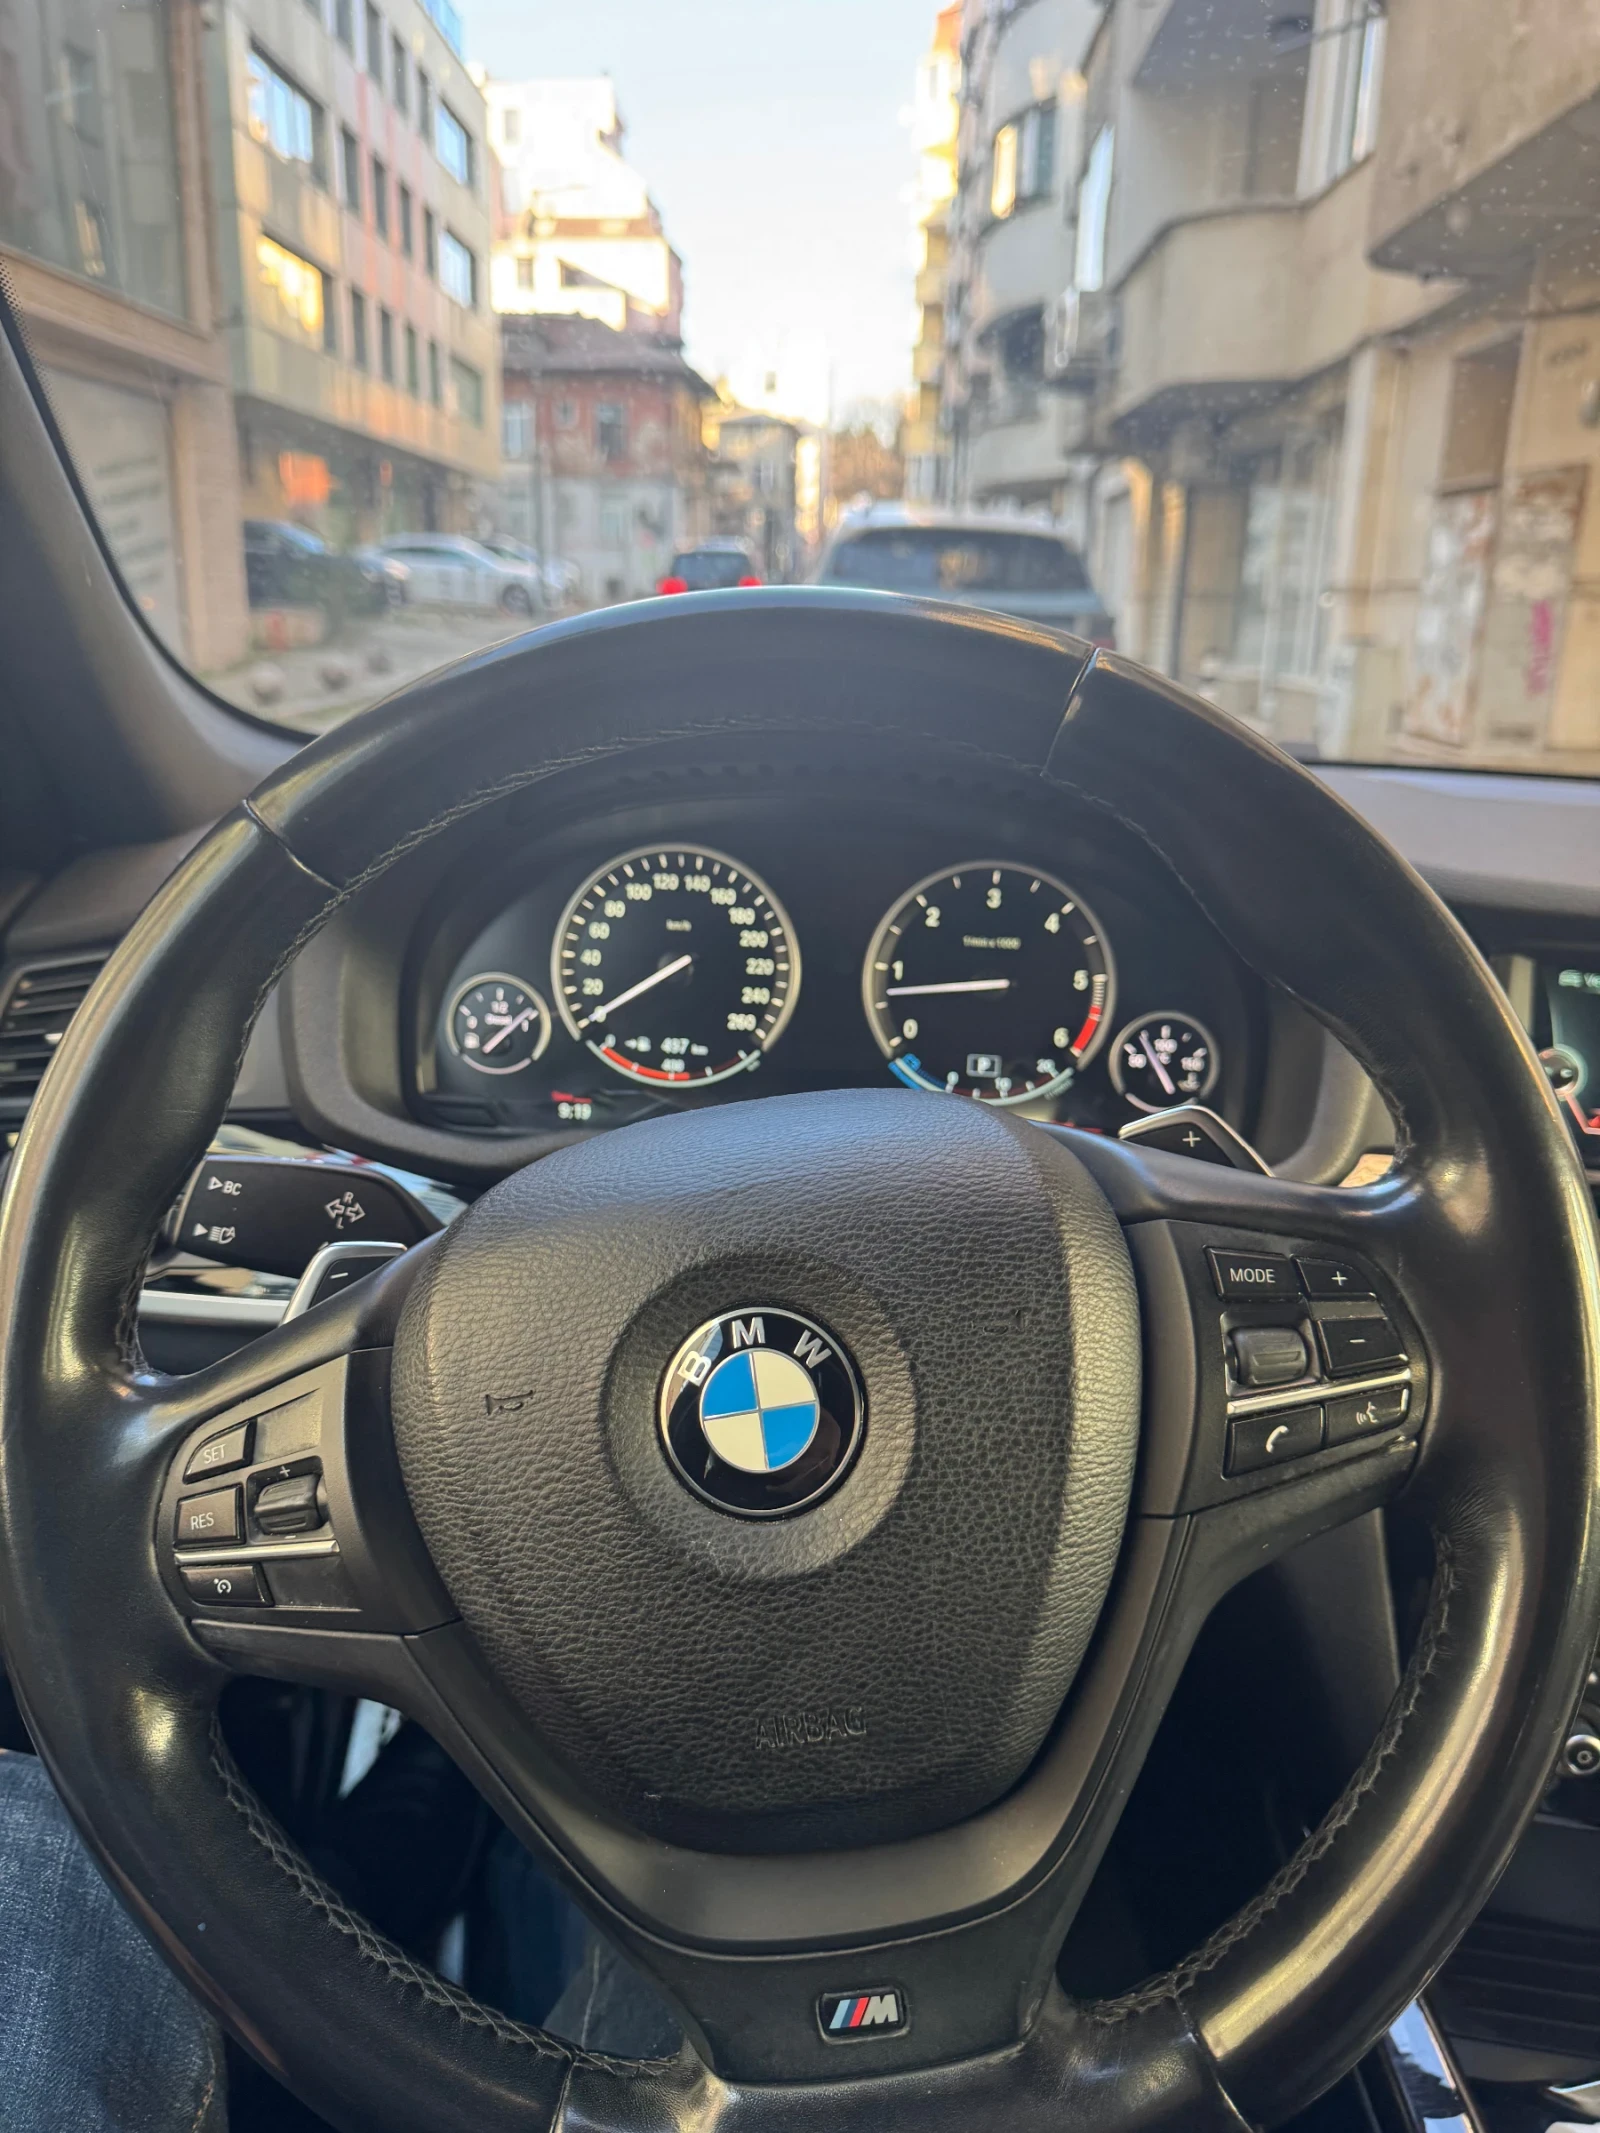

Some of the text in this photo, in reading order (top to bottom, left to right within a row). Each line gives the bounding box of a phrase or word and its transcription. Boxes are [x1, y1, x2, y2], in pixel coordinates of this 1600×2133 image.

[626, 883, 652, 900] 100
[652, 873, 679, 891] 120
[684, 875, 711, 892] 140
[710, 888, 737, 905] 160
[986, 887, 1002, 909] 3
[604, 900, 625, 918] 80
[728, 907, 756, 925] 180
[925, 906, 941, 928] 2
[589, 922, 610, 940] 60
[1044, 912, 1060, 934] 4
[739, 930, 768, 949] 200
[580, 948, 602, 967] 40
[746, 957, 774, 976] 220
[891, 959, 903, 980] 1
[582, 977, 604, 996] 20
[1073, 969, 1089, 991] 5
[741, 986, 770, 1005] 240
[727, 1012, 757, 1031] 260
[903, 1018, 918, 1040] 0
[1053, 1026, 1069, 1048] 6
[977, 1056, 991, 1075] P
[223, 1180, 242, 1196] BC
[343, 1191, 354, 1204] R
[336, 1217, 345, 1230] L
[1229, 1268, 1276, 1284] MODE
[677, 1316, 832, 1388] BMW
[203, 1444, 226, 1465] SET
[190, 1512, 215, 1531] RES
[756, 1706, 868, 1750] AIRBAG
[860, 1993, 899, 2027] M
